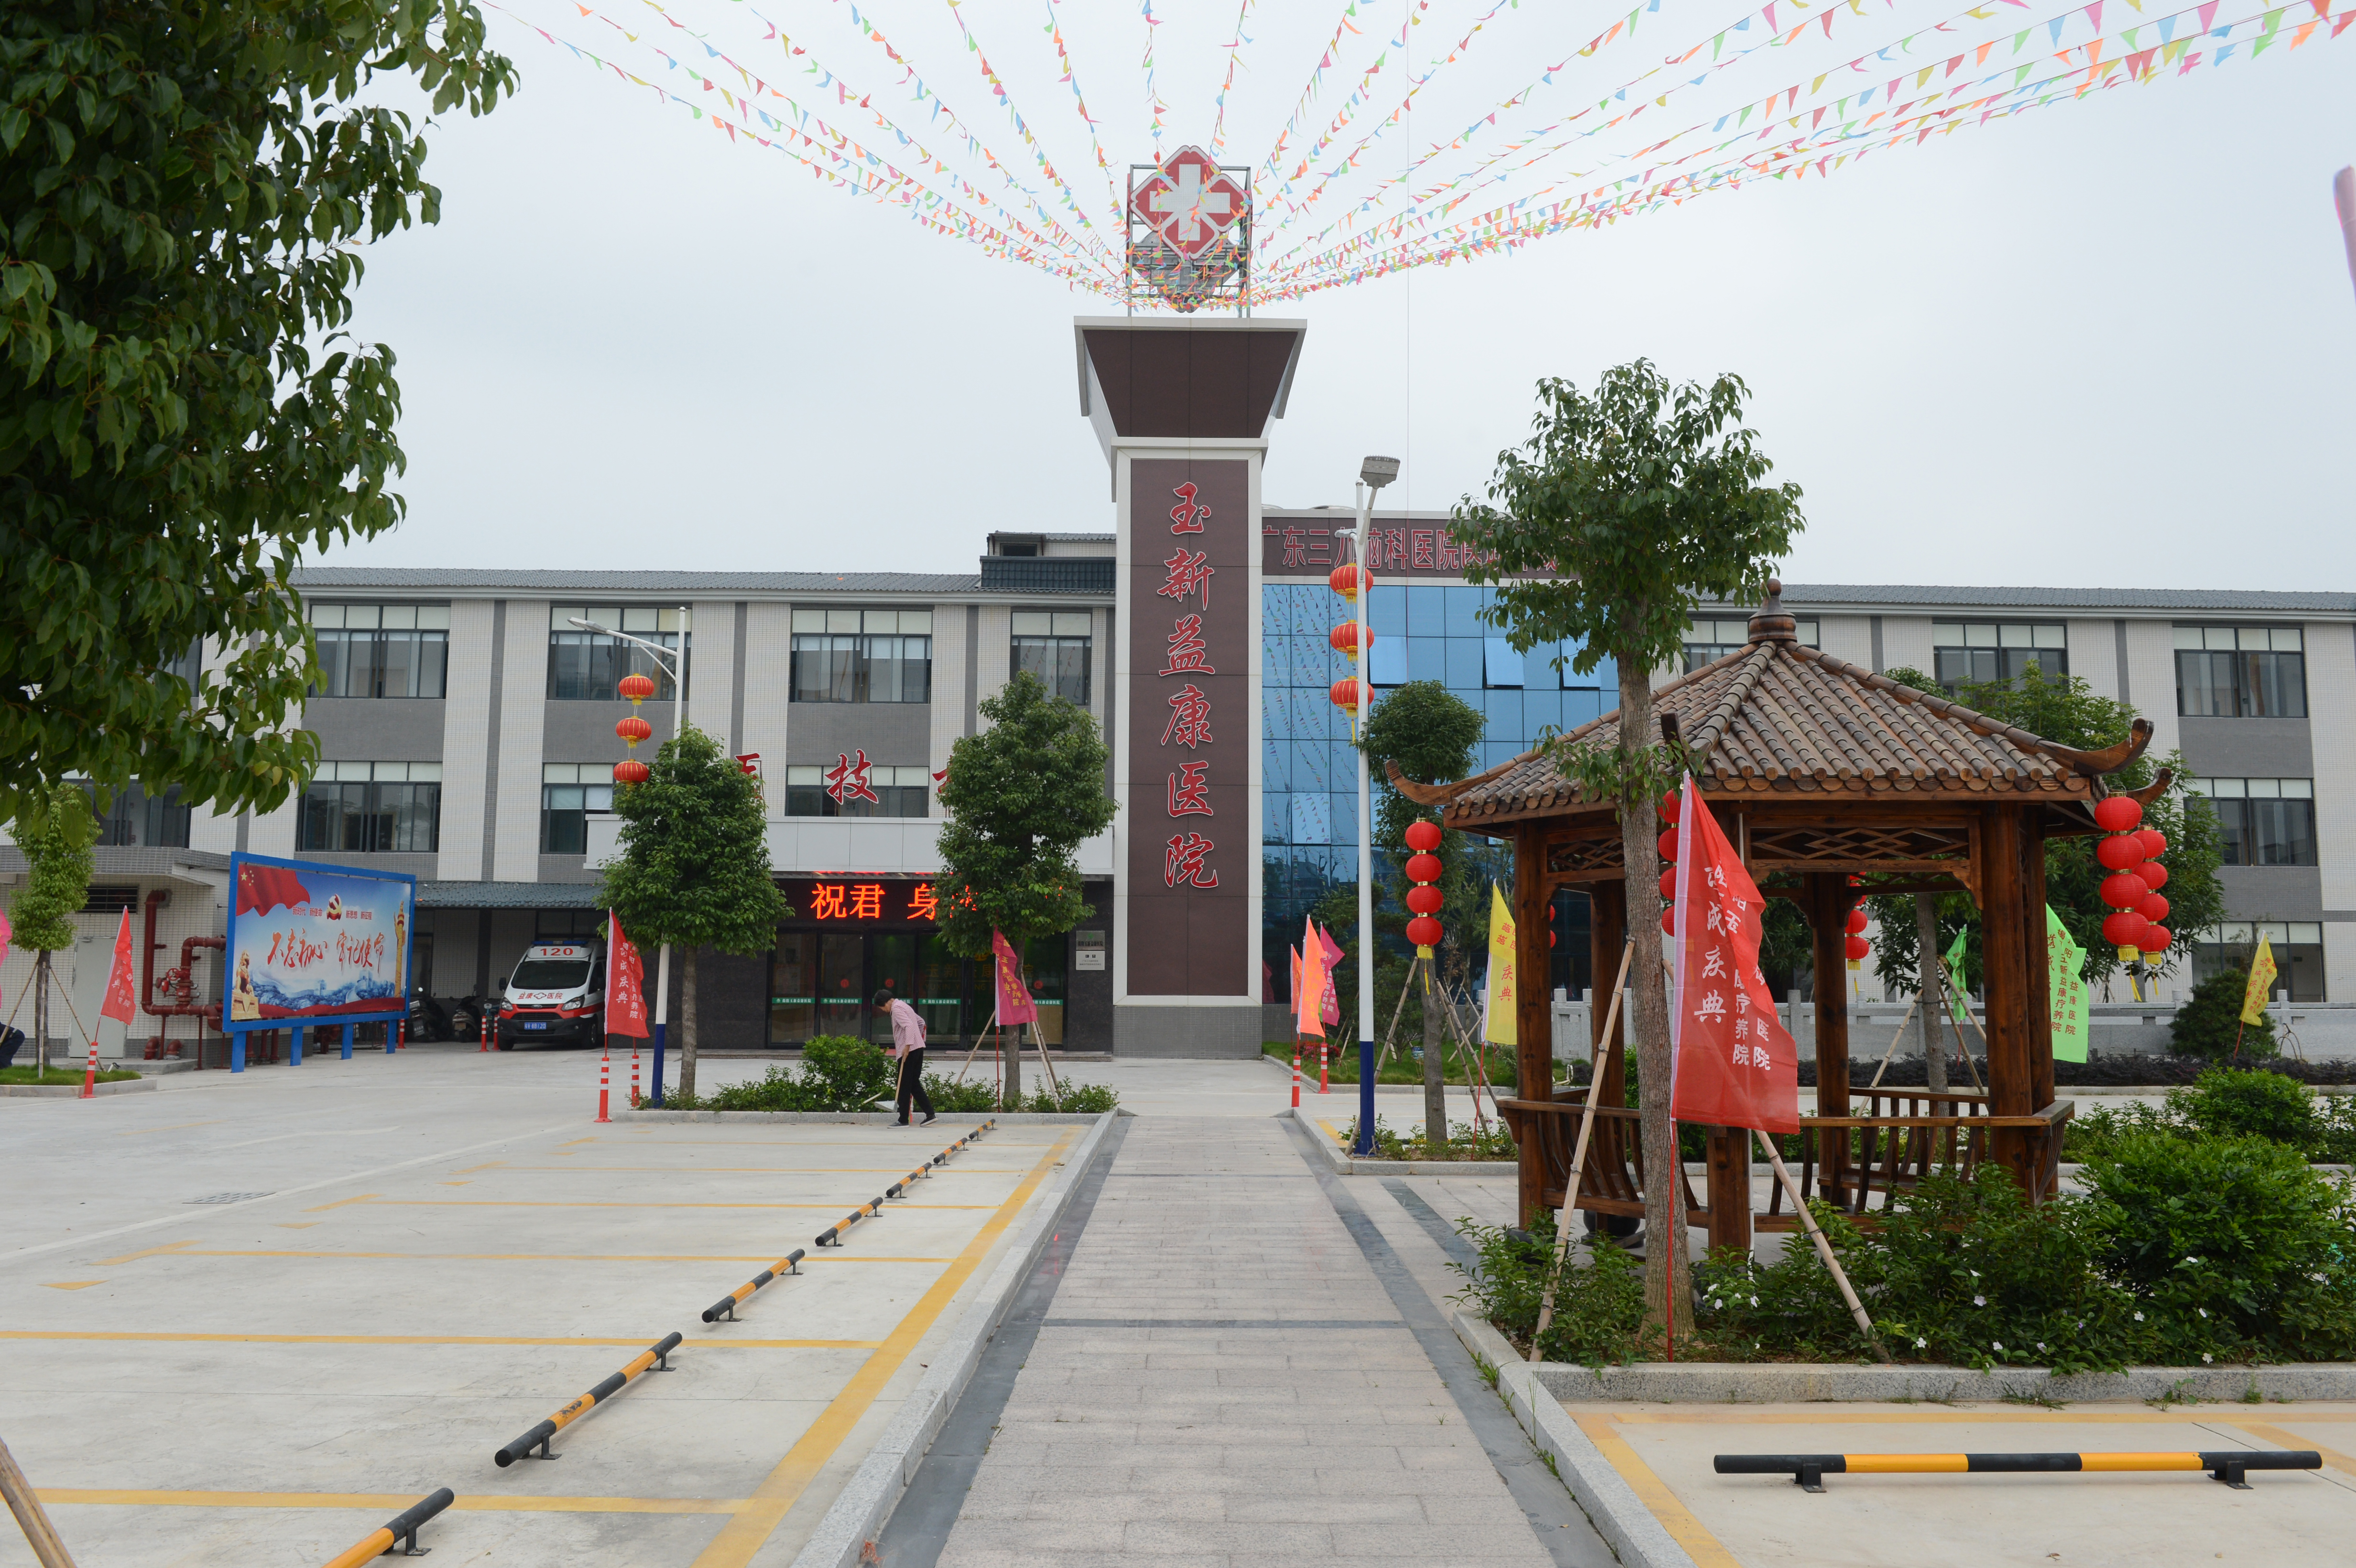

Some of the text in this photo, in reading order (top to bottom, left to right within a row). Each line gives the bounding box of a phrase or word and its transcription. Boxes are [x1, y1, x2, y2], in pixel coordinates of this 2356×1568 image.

[1157, 481, 1219, 889] 玉新益康医院
[293, 906, 372, 920] 新时代 新使命 新思想 新征程
[267, 927, 384, 974] 不忘初心 牢记使命
[540, 947, 574, 956] 120
[518, 991, 563, 1000] 益康 医院
